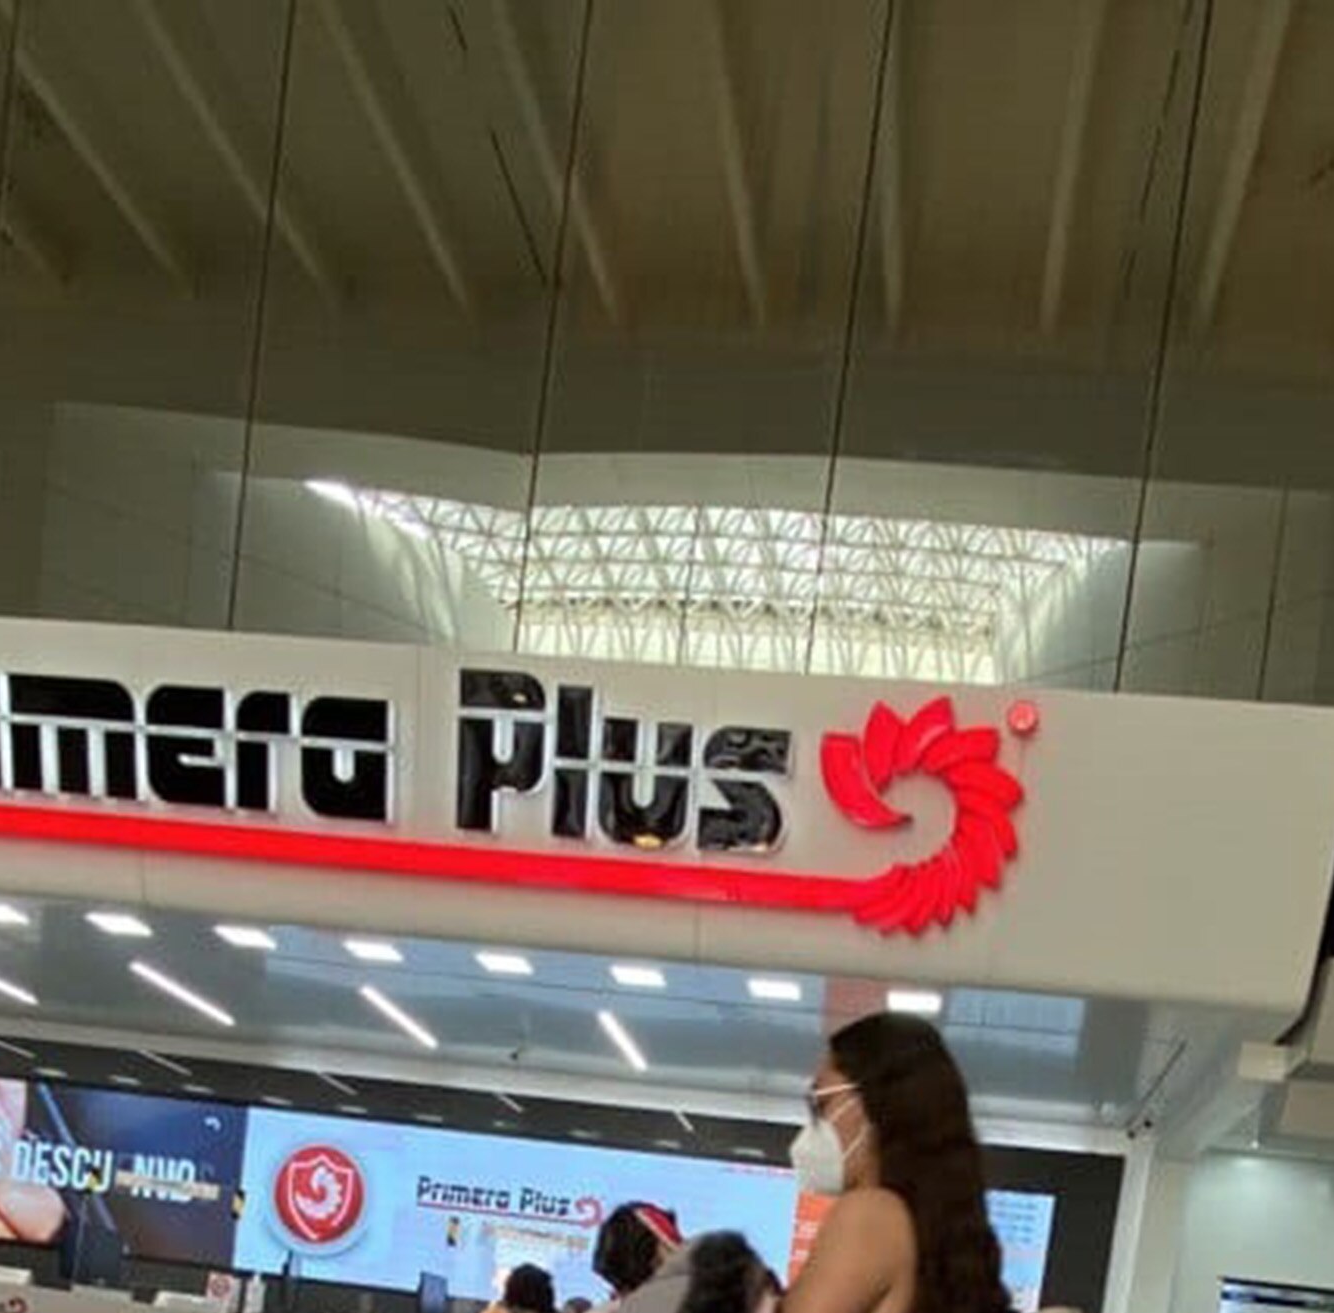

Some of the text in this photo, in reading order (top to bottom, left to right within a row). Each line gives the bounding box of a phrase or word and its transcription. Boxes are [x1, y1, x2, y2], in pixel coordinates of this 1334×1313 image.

[459, 666, 792, 854] Plus
[417, 1174, 572, 1217] Primera Plus
